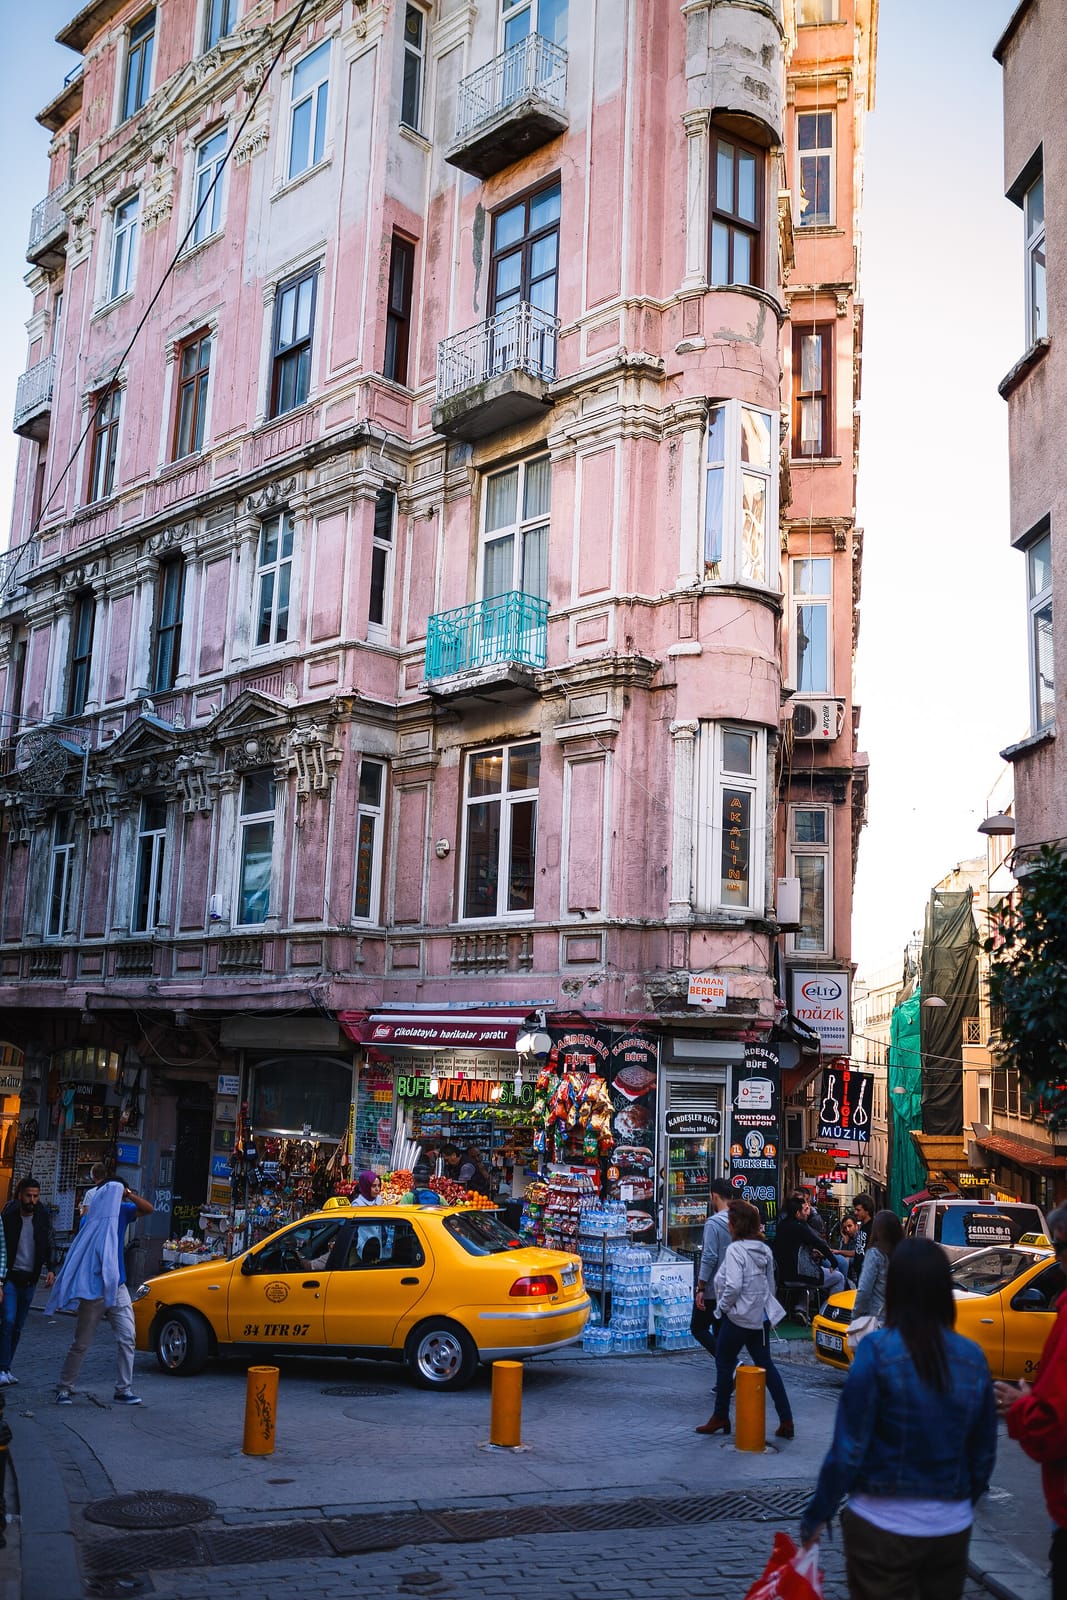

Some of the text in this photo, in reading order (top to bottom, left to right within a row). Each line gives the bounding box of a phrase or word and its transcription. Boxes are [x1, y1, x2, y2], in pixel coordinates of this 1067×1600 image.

[728, 798, 742, 880] AKALIN
[692, 976, 724, 986] YAMAN
[690, 986, 724, 997] BERBER
[797, 1005, 844, 1020] müzik
[394, 1027, 438, 1039] Çikolatayla
[440, 1030, 477, 1039] harikalar
[479, 1030, 508, 1040] yaratır
[553, 1034, 609, 1060] ARDEŞLER
[625, 1052, 647, 1062] BÜFE
[746, 1060, 767, 1069] BÜFE
[397, 1074, 433, 1098] BÜFE
[437, 1077, 501, 1103] VİTAMİN
[841, 1071, 850, 1128] BİLGE
[668, 1114, 719, 1127] KARDEŞLER BÜFE
[821, 1126, 867, 1141] MÜZİK
[733, 1159, 776, 1169] TURKCELL
[742, 1186, 775, 1201] avea
[243, 1323, 310, 1336] 34 TFR 97
